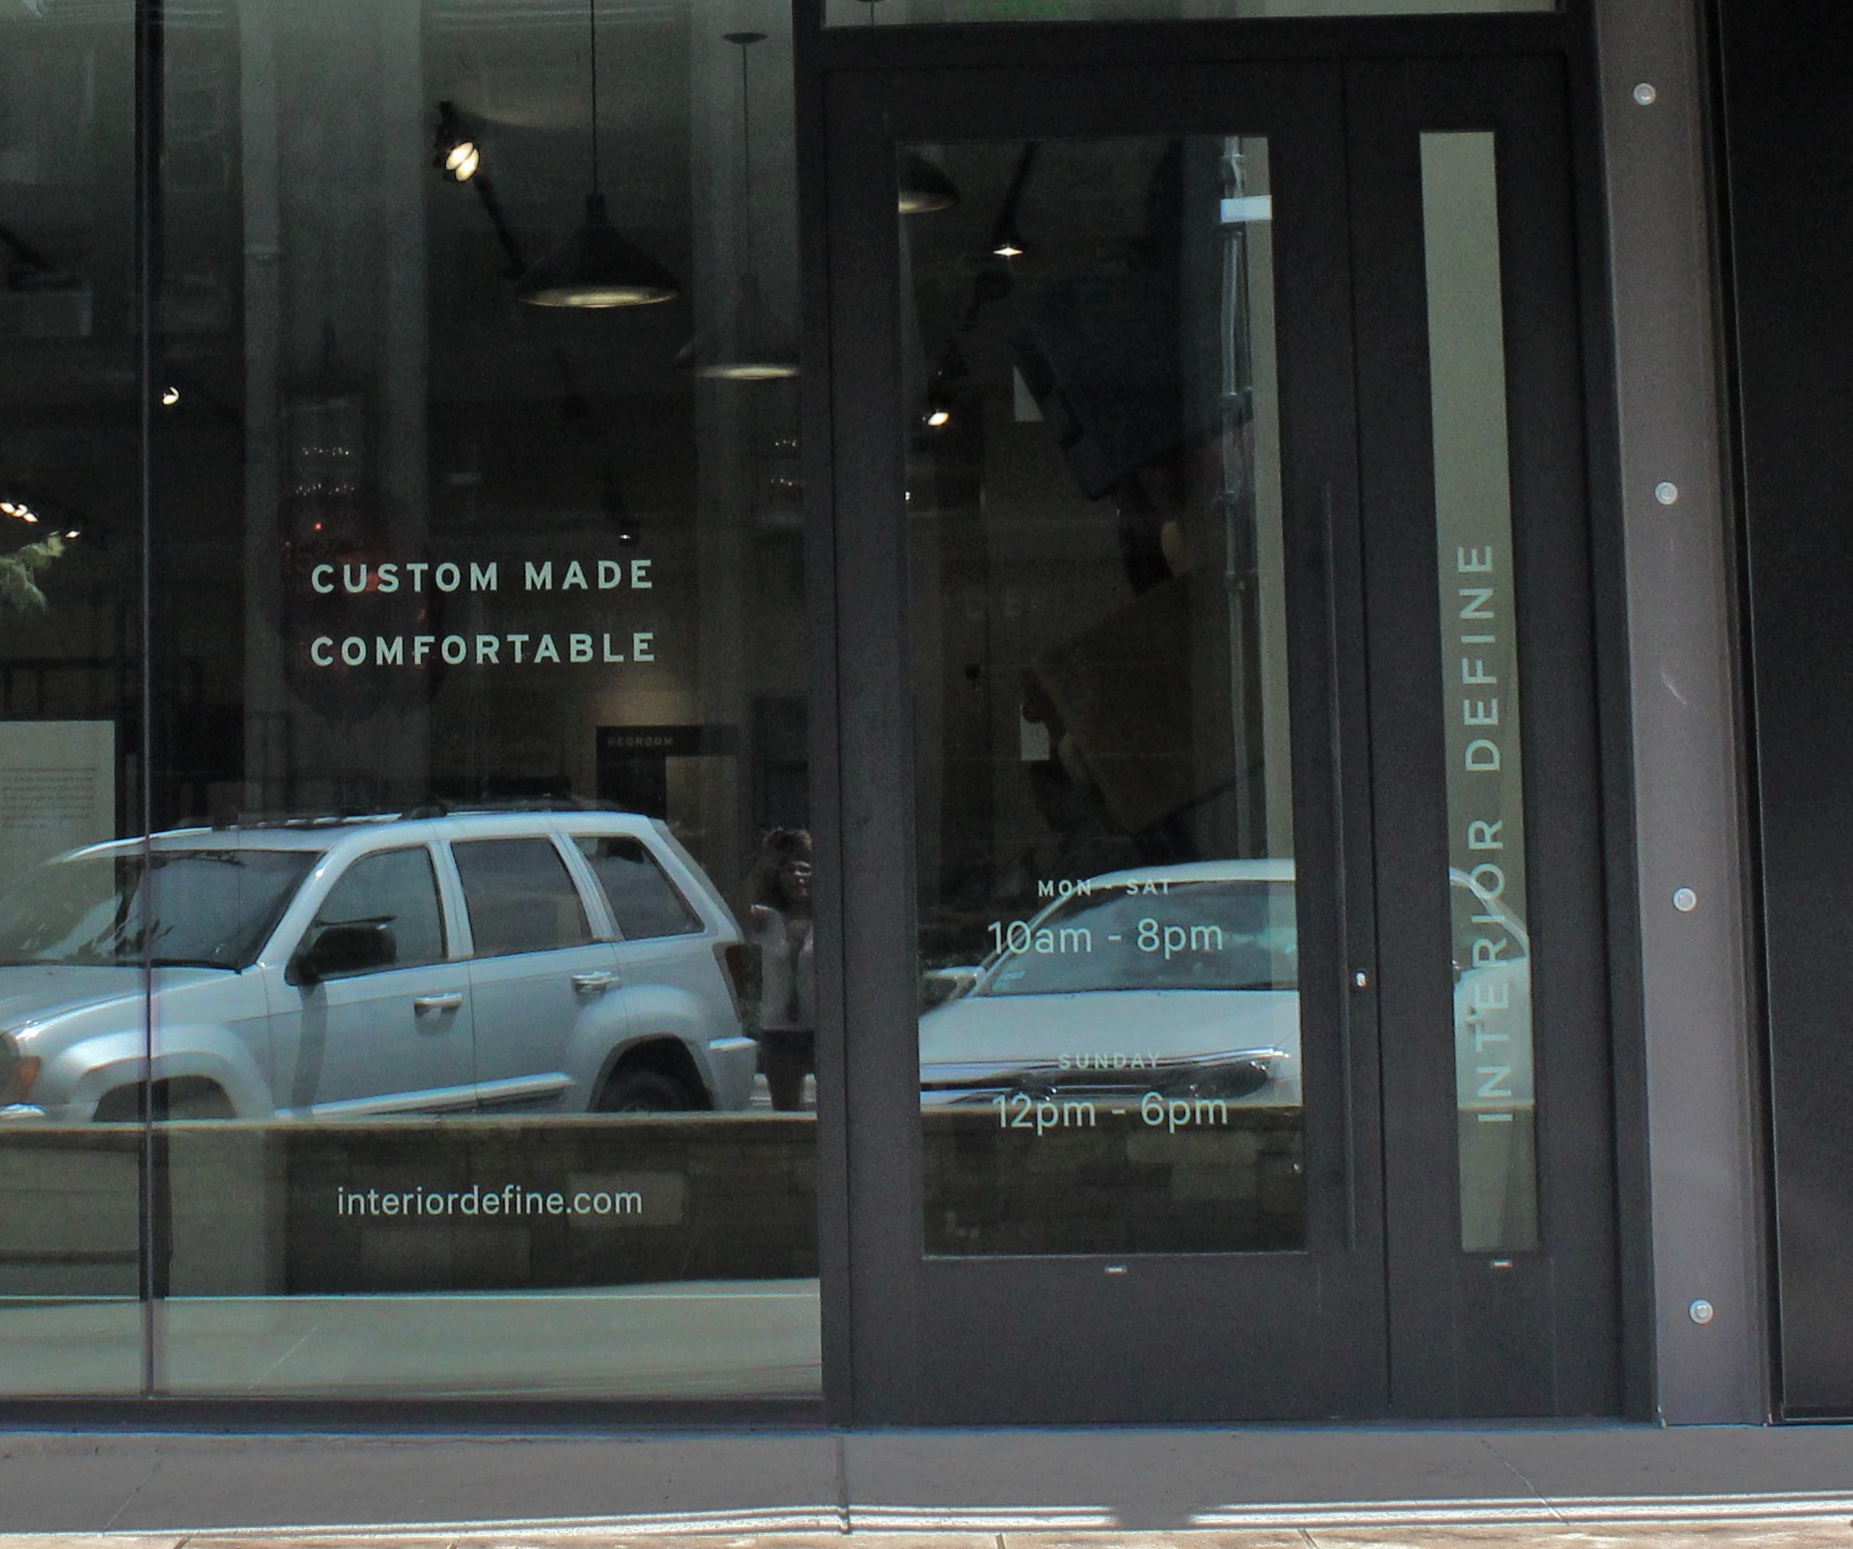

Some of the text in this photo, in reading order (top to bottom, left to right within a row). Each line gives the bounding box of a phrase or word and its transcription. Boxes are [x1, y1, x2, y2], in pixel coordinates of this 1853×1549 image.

[311, 559, 653, 593] CUSTOM MADE
[311, 632, 655, 666] COMFORTABLE
[1457, 545, 1514, 1123] INTERIOR DEFINE
[1037, 879, 1092, 897] MON
[1126, 878, 1172, 896] SAT
[987, 920, 1092, 955] 10am
[1137, 918, 1223, 960] 8pm
[1058, 1052, 1161, 1070] SUNDAY
[993, 1093, 1097, 1136] 12pm
[1141, 1091, 1228, 1134] 6pm
[337, 1184, 643, 1216] interiordefine.com
